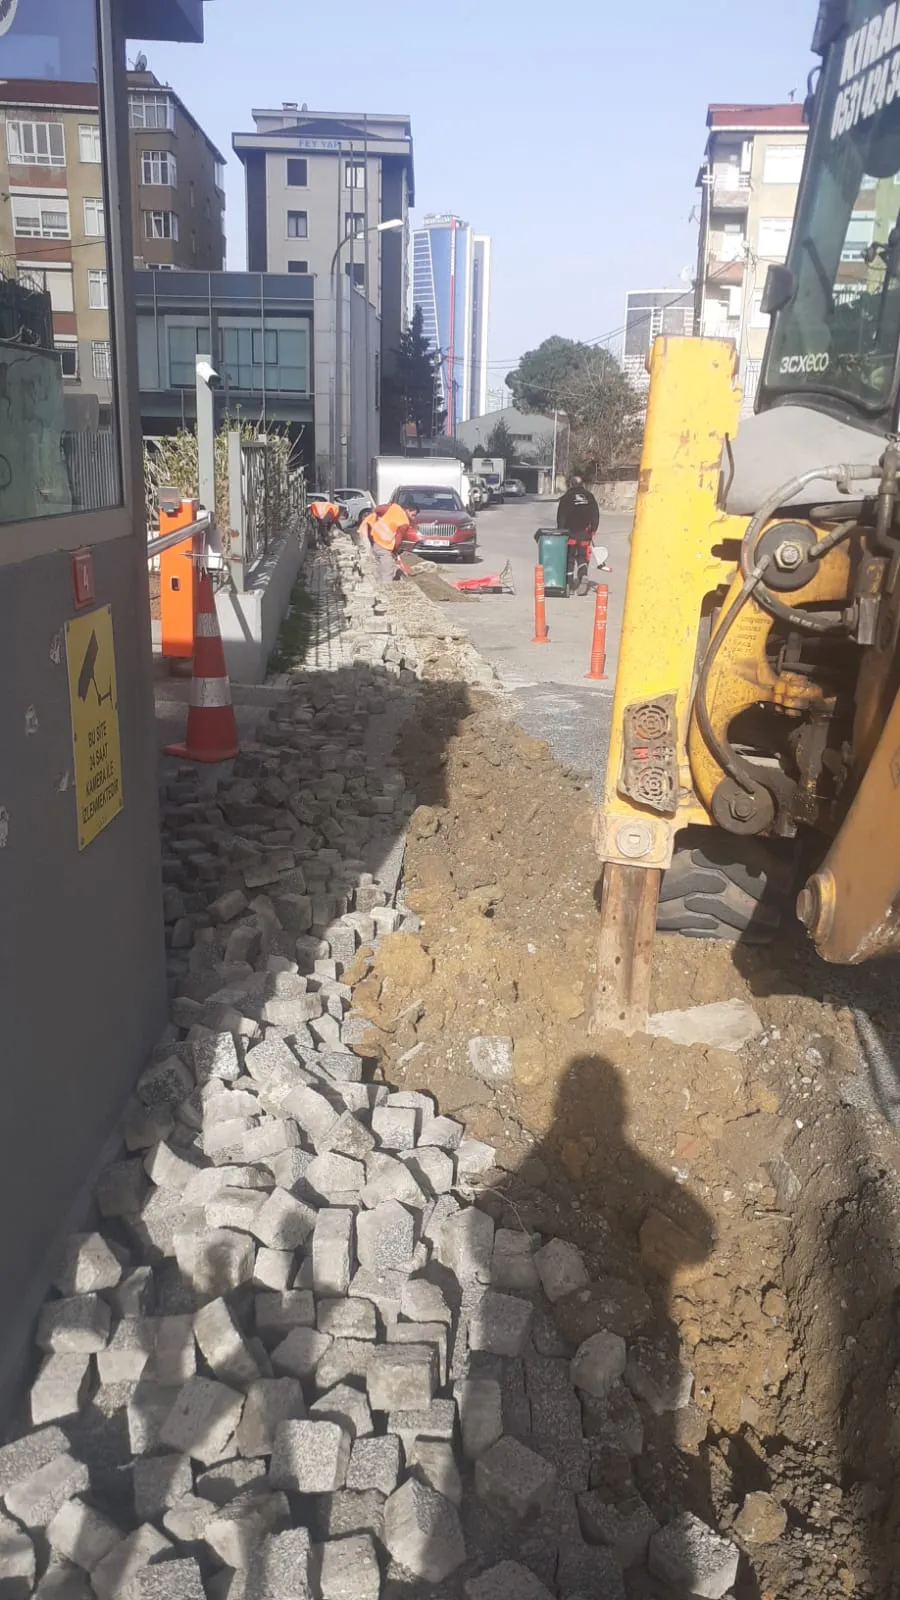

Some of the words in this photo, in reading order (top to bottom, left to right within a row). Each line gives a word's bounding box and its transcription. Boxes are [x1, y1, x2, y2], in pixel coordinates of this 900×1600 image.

[88, 728, 96, 748] BU
[96, 719, 107, 742] SİTE
[95, 742, 108, 766] SAAT
[86, 767, 107, 796] KAMERA
